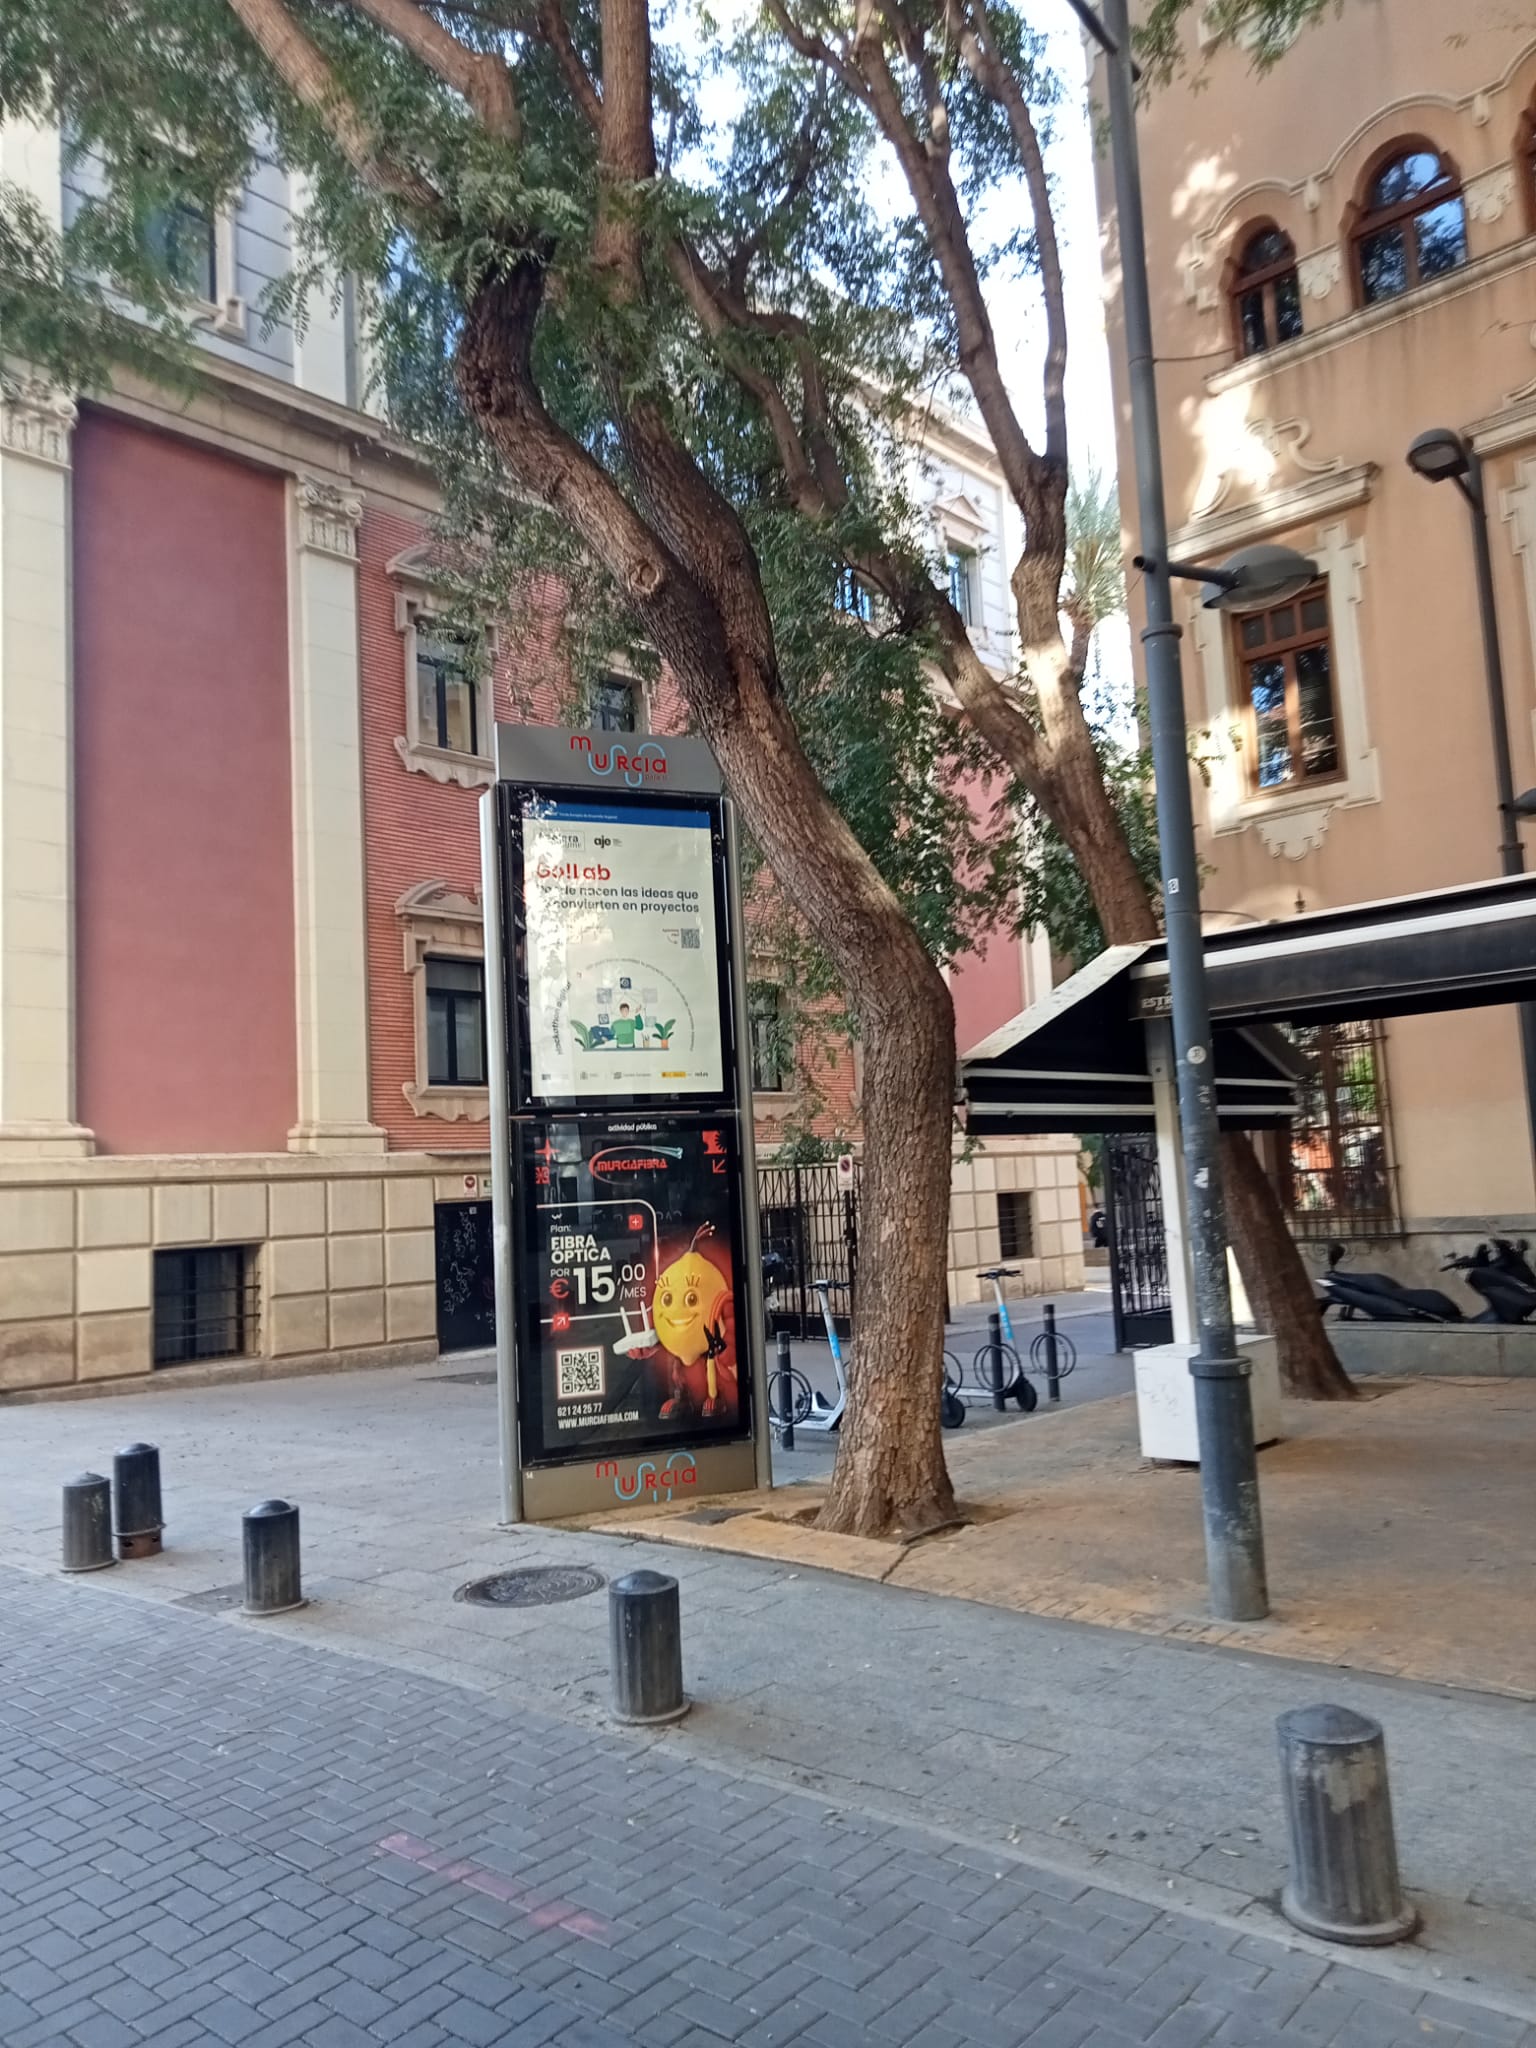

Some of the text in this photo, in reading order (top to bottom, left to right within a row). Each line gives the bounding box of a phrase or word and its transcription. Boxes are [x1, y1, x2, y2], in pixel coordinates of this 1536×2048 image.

[621, 886, 638, 897] las
[641, 886, 674, 899] ideas
[676, 890, 699, 902] que
[622, 902, 638, 911] en
[640, 902, 699, 915] proyectos
[597, 1158, 668, 1172] MURCIAFIBRA
[550, 1224, 572, 1233] Plan:
[551, 1234, 597, 1250] FIBRA
[551, 1246, 611, 1264] ÓPTICA
[550, 1268, 570, 1278] POR
